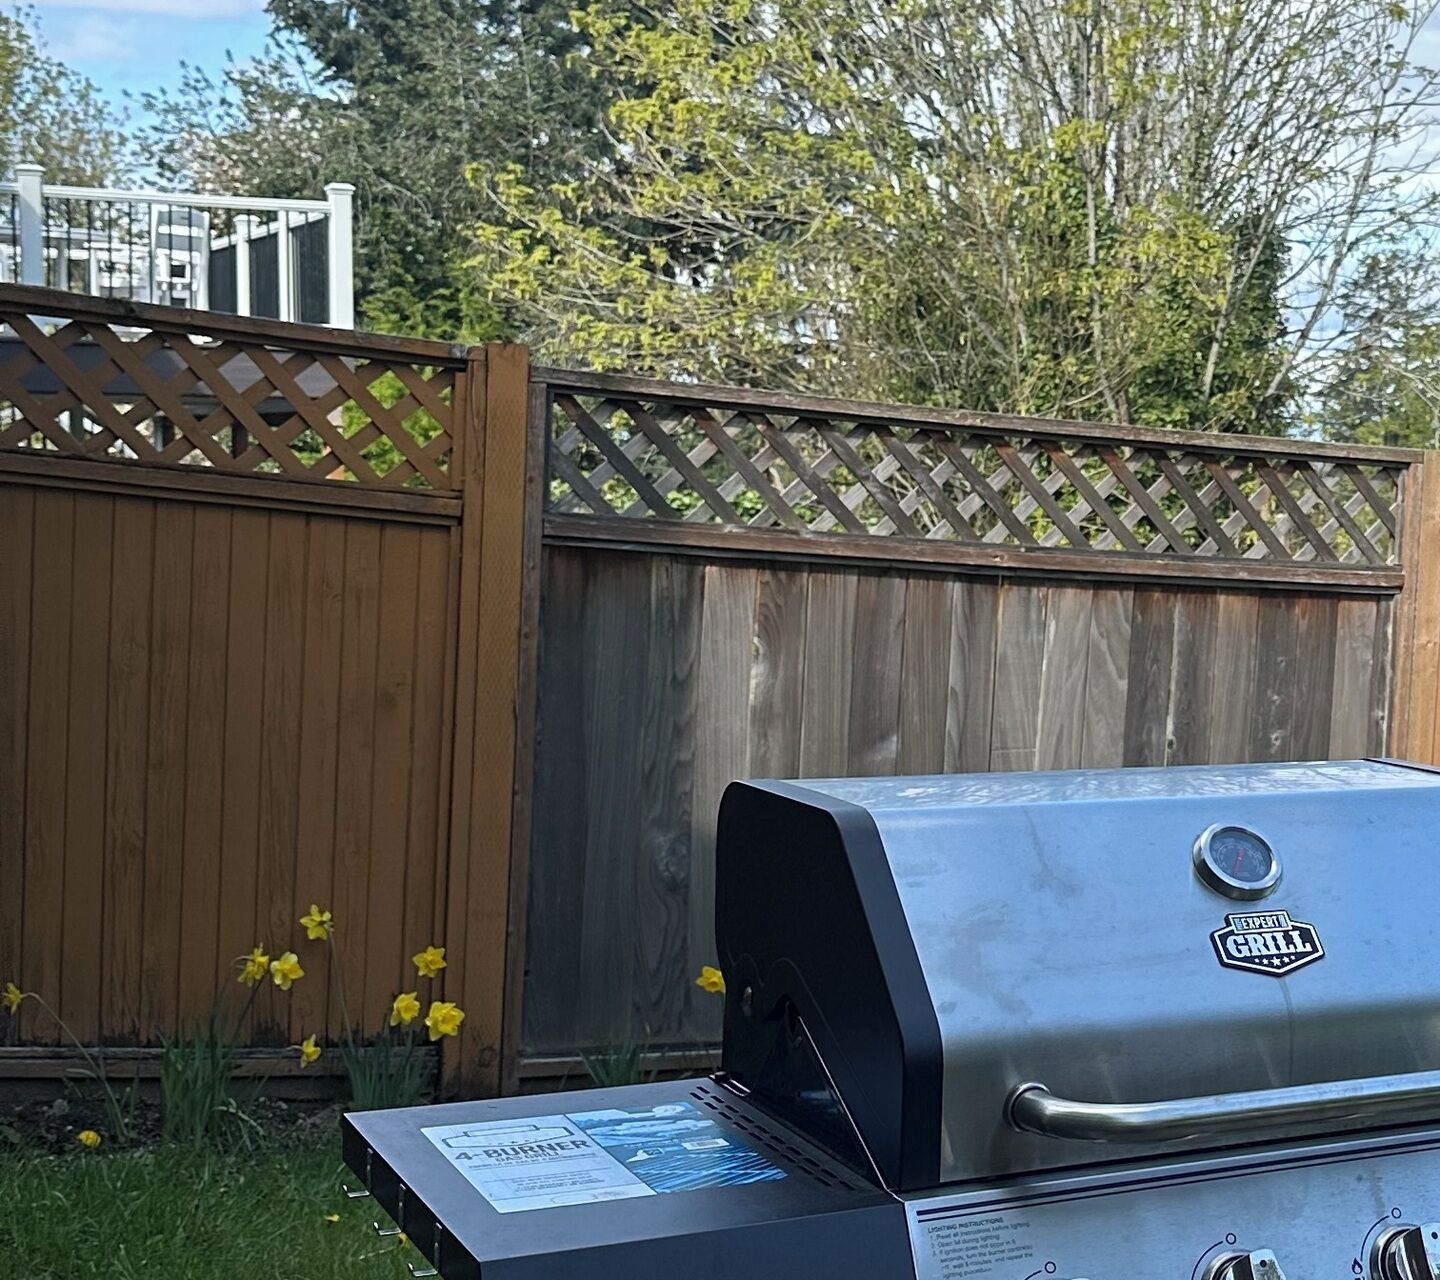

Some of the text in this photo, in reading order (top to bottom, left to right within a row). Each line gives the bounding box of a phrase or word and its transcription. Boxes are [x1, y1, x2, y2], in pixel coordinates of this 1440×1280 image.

[1241, 915, 1279, 929] EXPERT
[1226, 931, 1313, 957] GRILL
[455, 1140, 592, 1160] 4-BURNER
[959, 1217, 1003, 1228] INSTRUCTIONS
